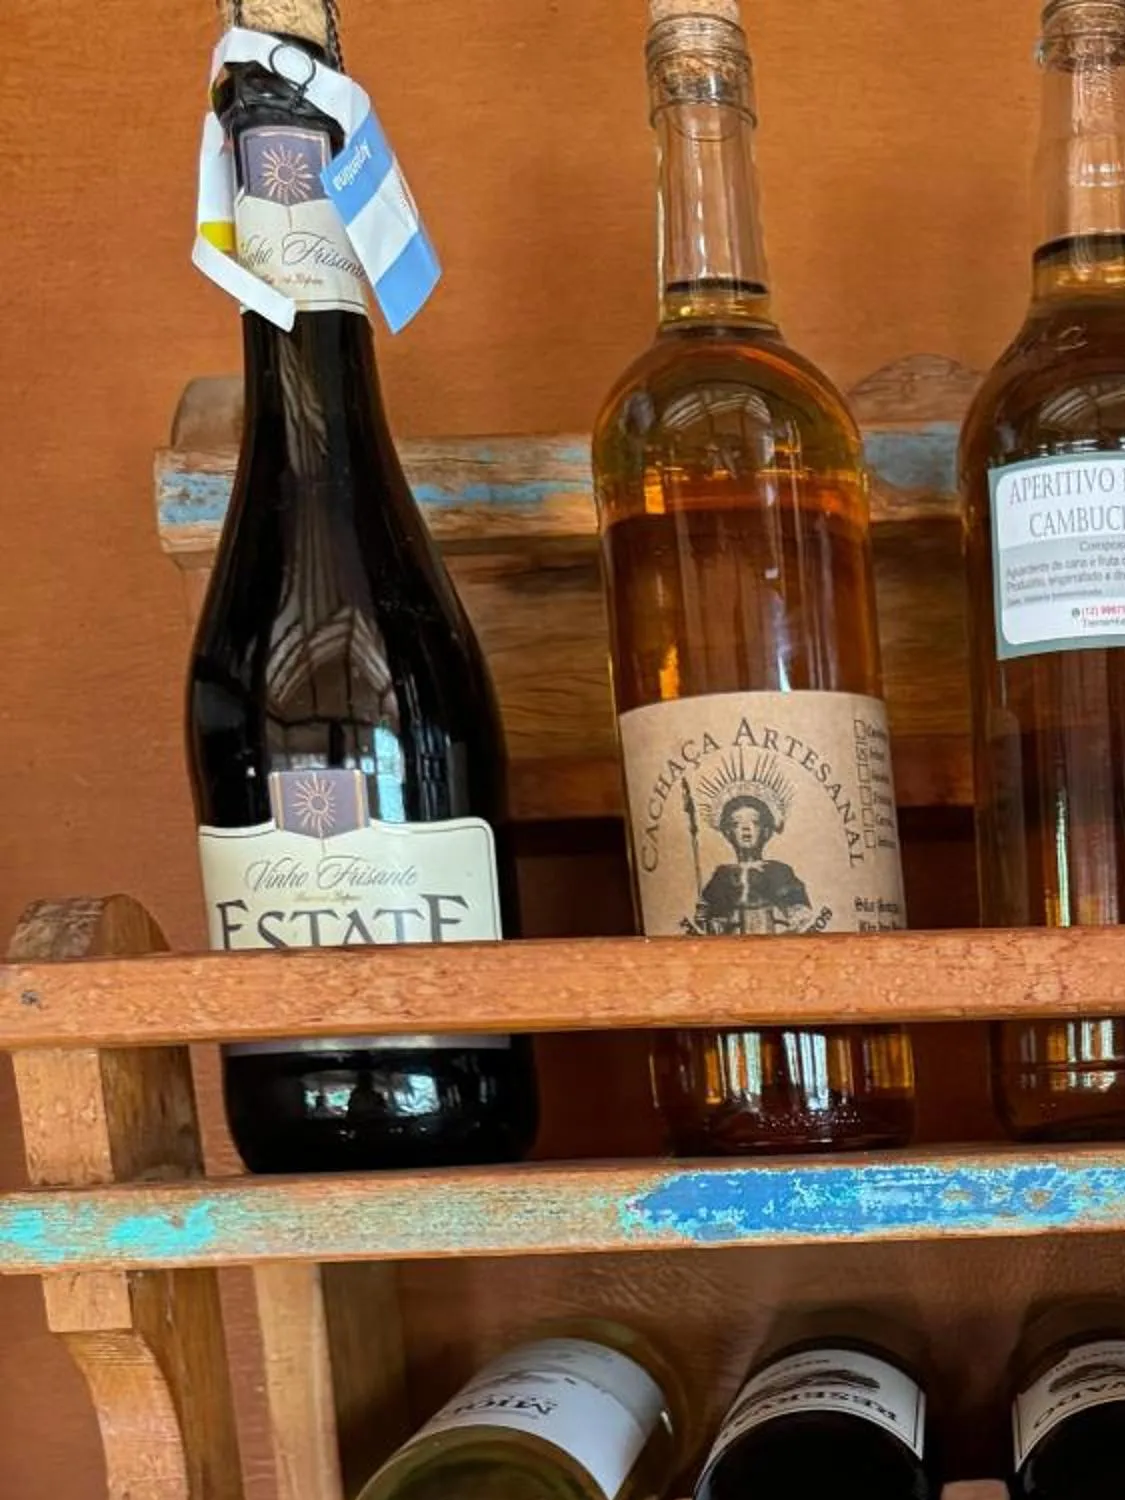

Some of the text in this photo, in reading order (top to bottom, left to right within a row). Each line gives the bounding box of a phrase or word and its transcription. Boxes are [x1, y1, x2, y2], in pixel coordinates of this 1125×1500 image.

[1009, 468, 1115, 505] APERITIVO
[640, 731, 721, 873] CACHAÇA
[732, 716, 865, 870] ARTESANAL
[245, 855, 420, 892] Vinho Frisante
